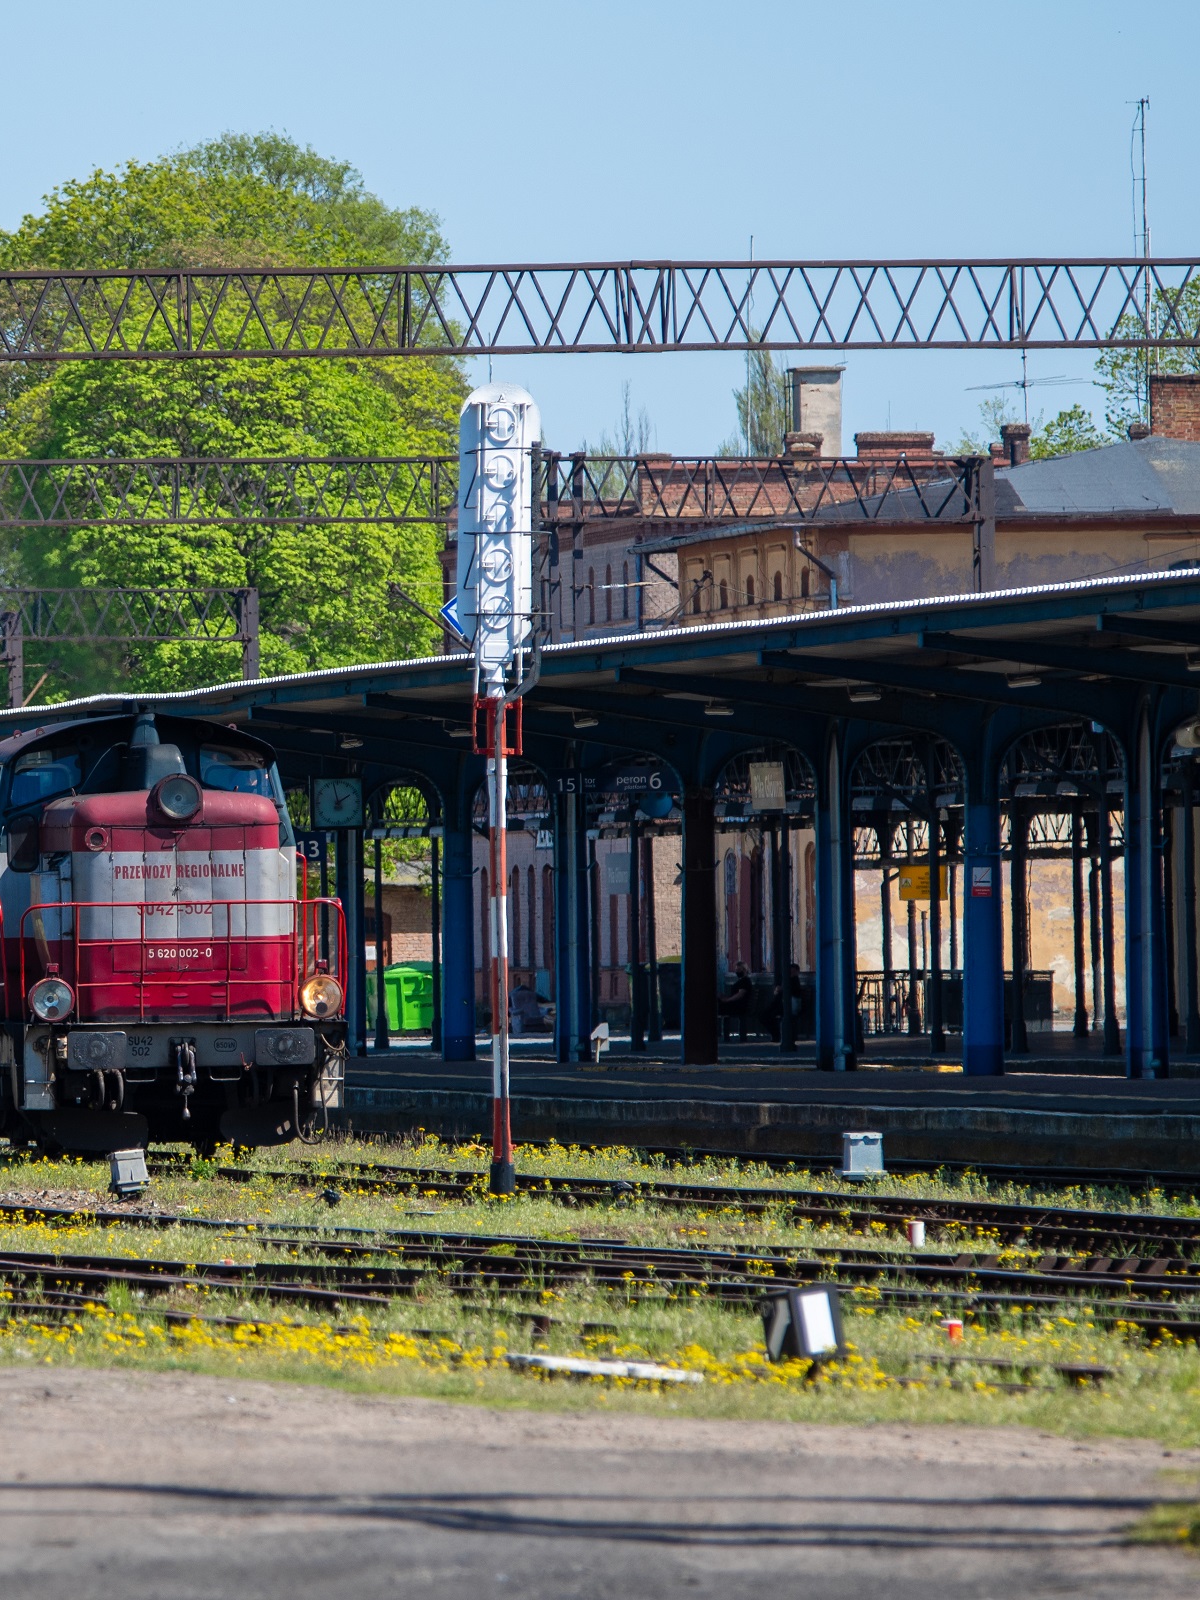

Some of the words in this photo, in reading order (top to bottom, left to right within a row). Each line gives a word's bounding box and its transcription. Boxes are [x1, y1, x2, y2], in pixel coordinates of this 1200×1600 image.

[557, 778, 576, 792] 15
[616, 775, 647, 786] peron
[649, 772, 662, 789] 6
[297, 840, 320, 858] 13
[114, 864, 172, 879] PRZEWOZY
[177, 864, 245, 878] REGIONALNE
[148, 950, 155, 959] 5
[157, 949, 177, 958] 620
[128, 1036, 153, 1046] SU42
[131, 1047, 150, 1057] 502
